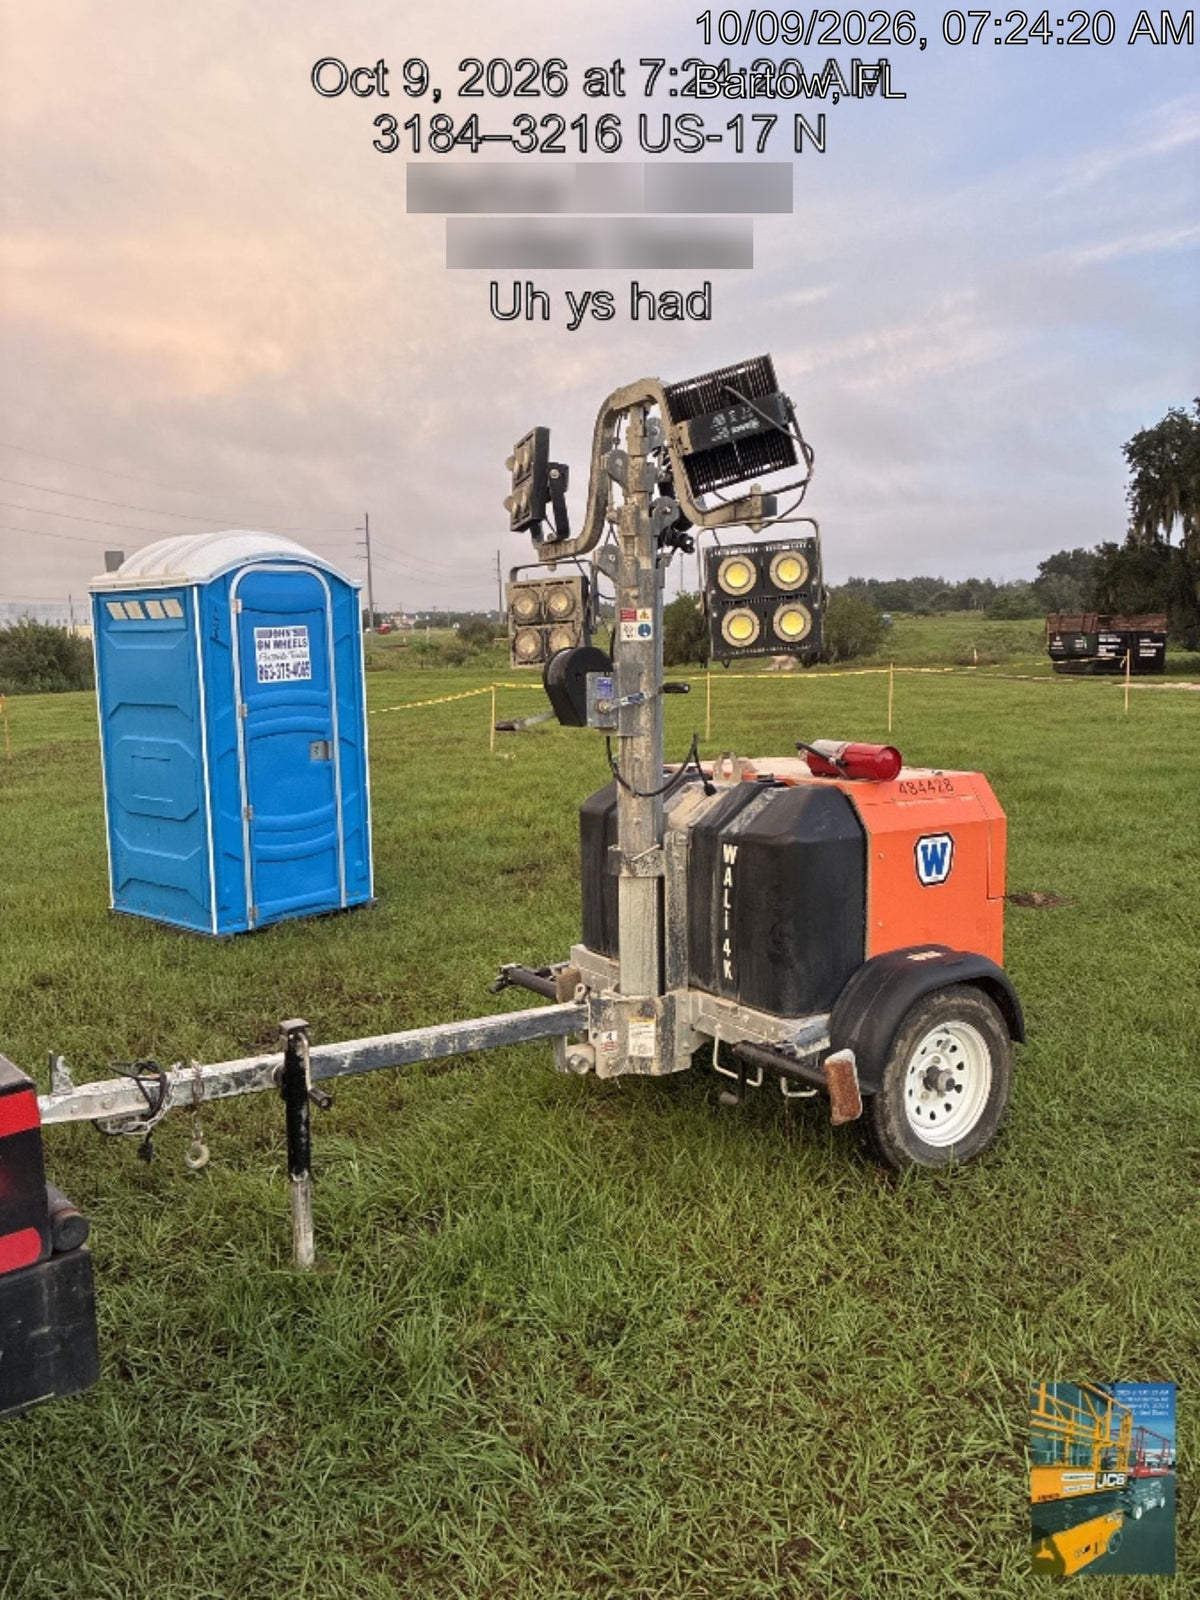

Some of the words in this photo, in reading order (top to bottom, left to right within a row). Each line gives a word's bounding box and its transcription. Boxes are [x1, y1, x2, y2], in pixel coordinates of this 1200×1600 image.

[257, 639, 271, 651] ON
[273, 637, 308, 650] WHEELS
[920, 842, 949, 877] W
